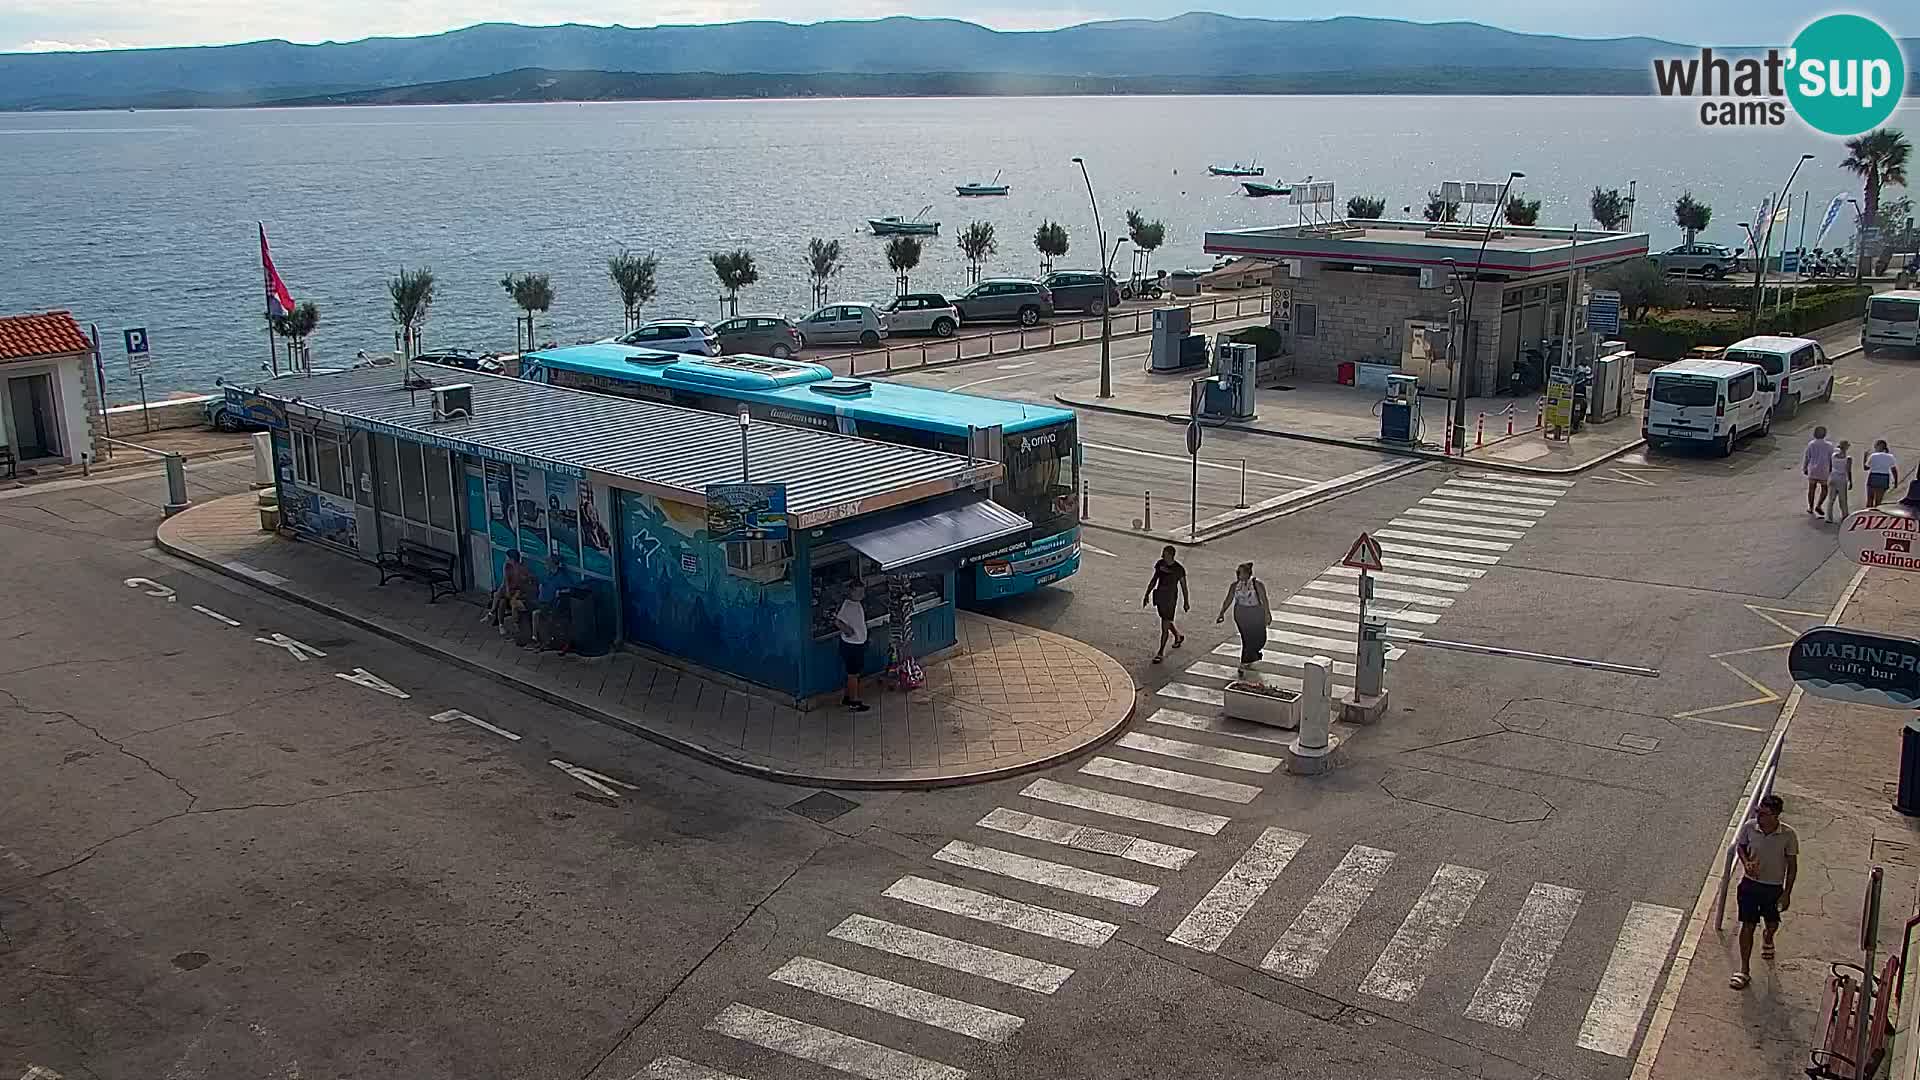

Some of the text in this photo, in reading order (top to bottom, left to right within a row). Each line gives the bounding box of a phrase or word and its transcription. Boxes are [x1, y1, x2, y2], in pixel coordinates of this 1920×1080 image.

[129, 331, 143, 350] P
[1032, 432, 1056, 447] arriva
[493, 448, 527, 466] STATION
[527, 457, 554, 472] TICKET
[554, 462, 583, 478] OFFICE
[1848, 515, 1920, 533] PIZZE
[1882, 530, 1918, 541] GRILL
[1801, 642, 1920, 674] MARINER
[1829, 662, 1897, 680] caffe bar
